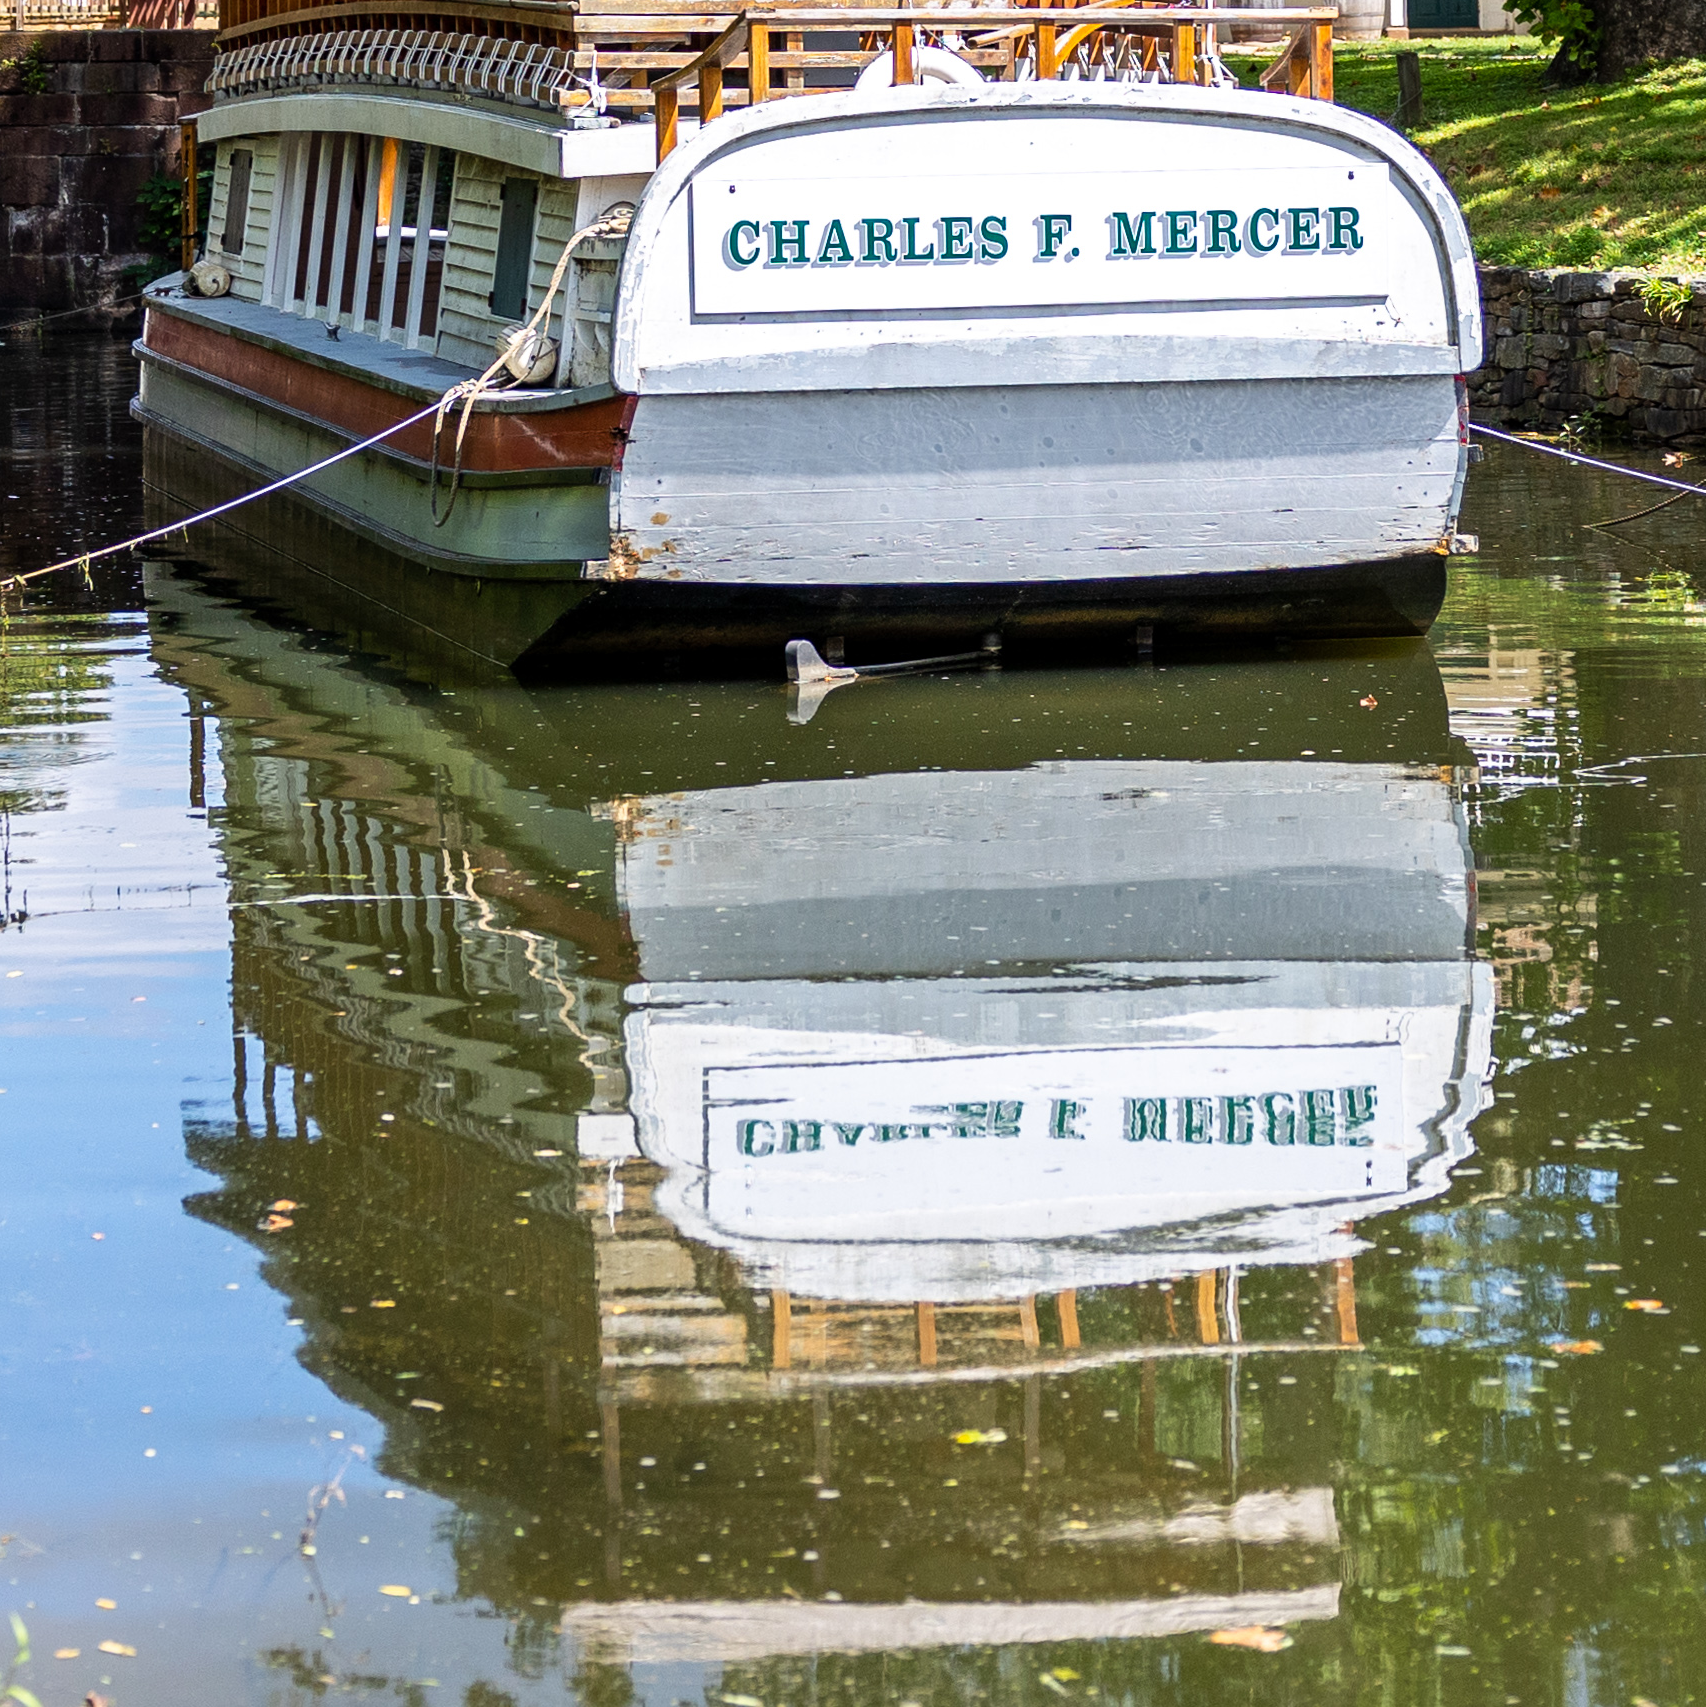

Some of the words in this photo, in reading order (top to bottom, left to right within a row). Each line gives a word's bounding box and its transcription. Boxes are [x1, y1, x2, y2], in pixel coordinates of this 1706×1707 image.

[723, 215, 1010, 270] CHARLES
[1034, 214, 1081, 261] F.
[1106, 206, 1364, 260] MERCER
